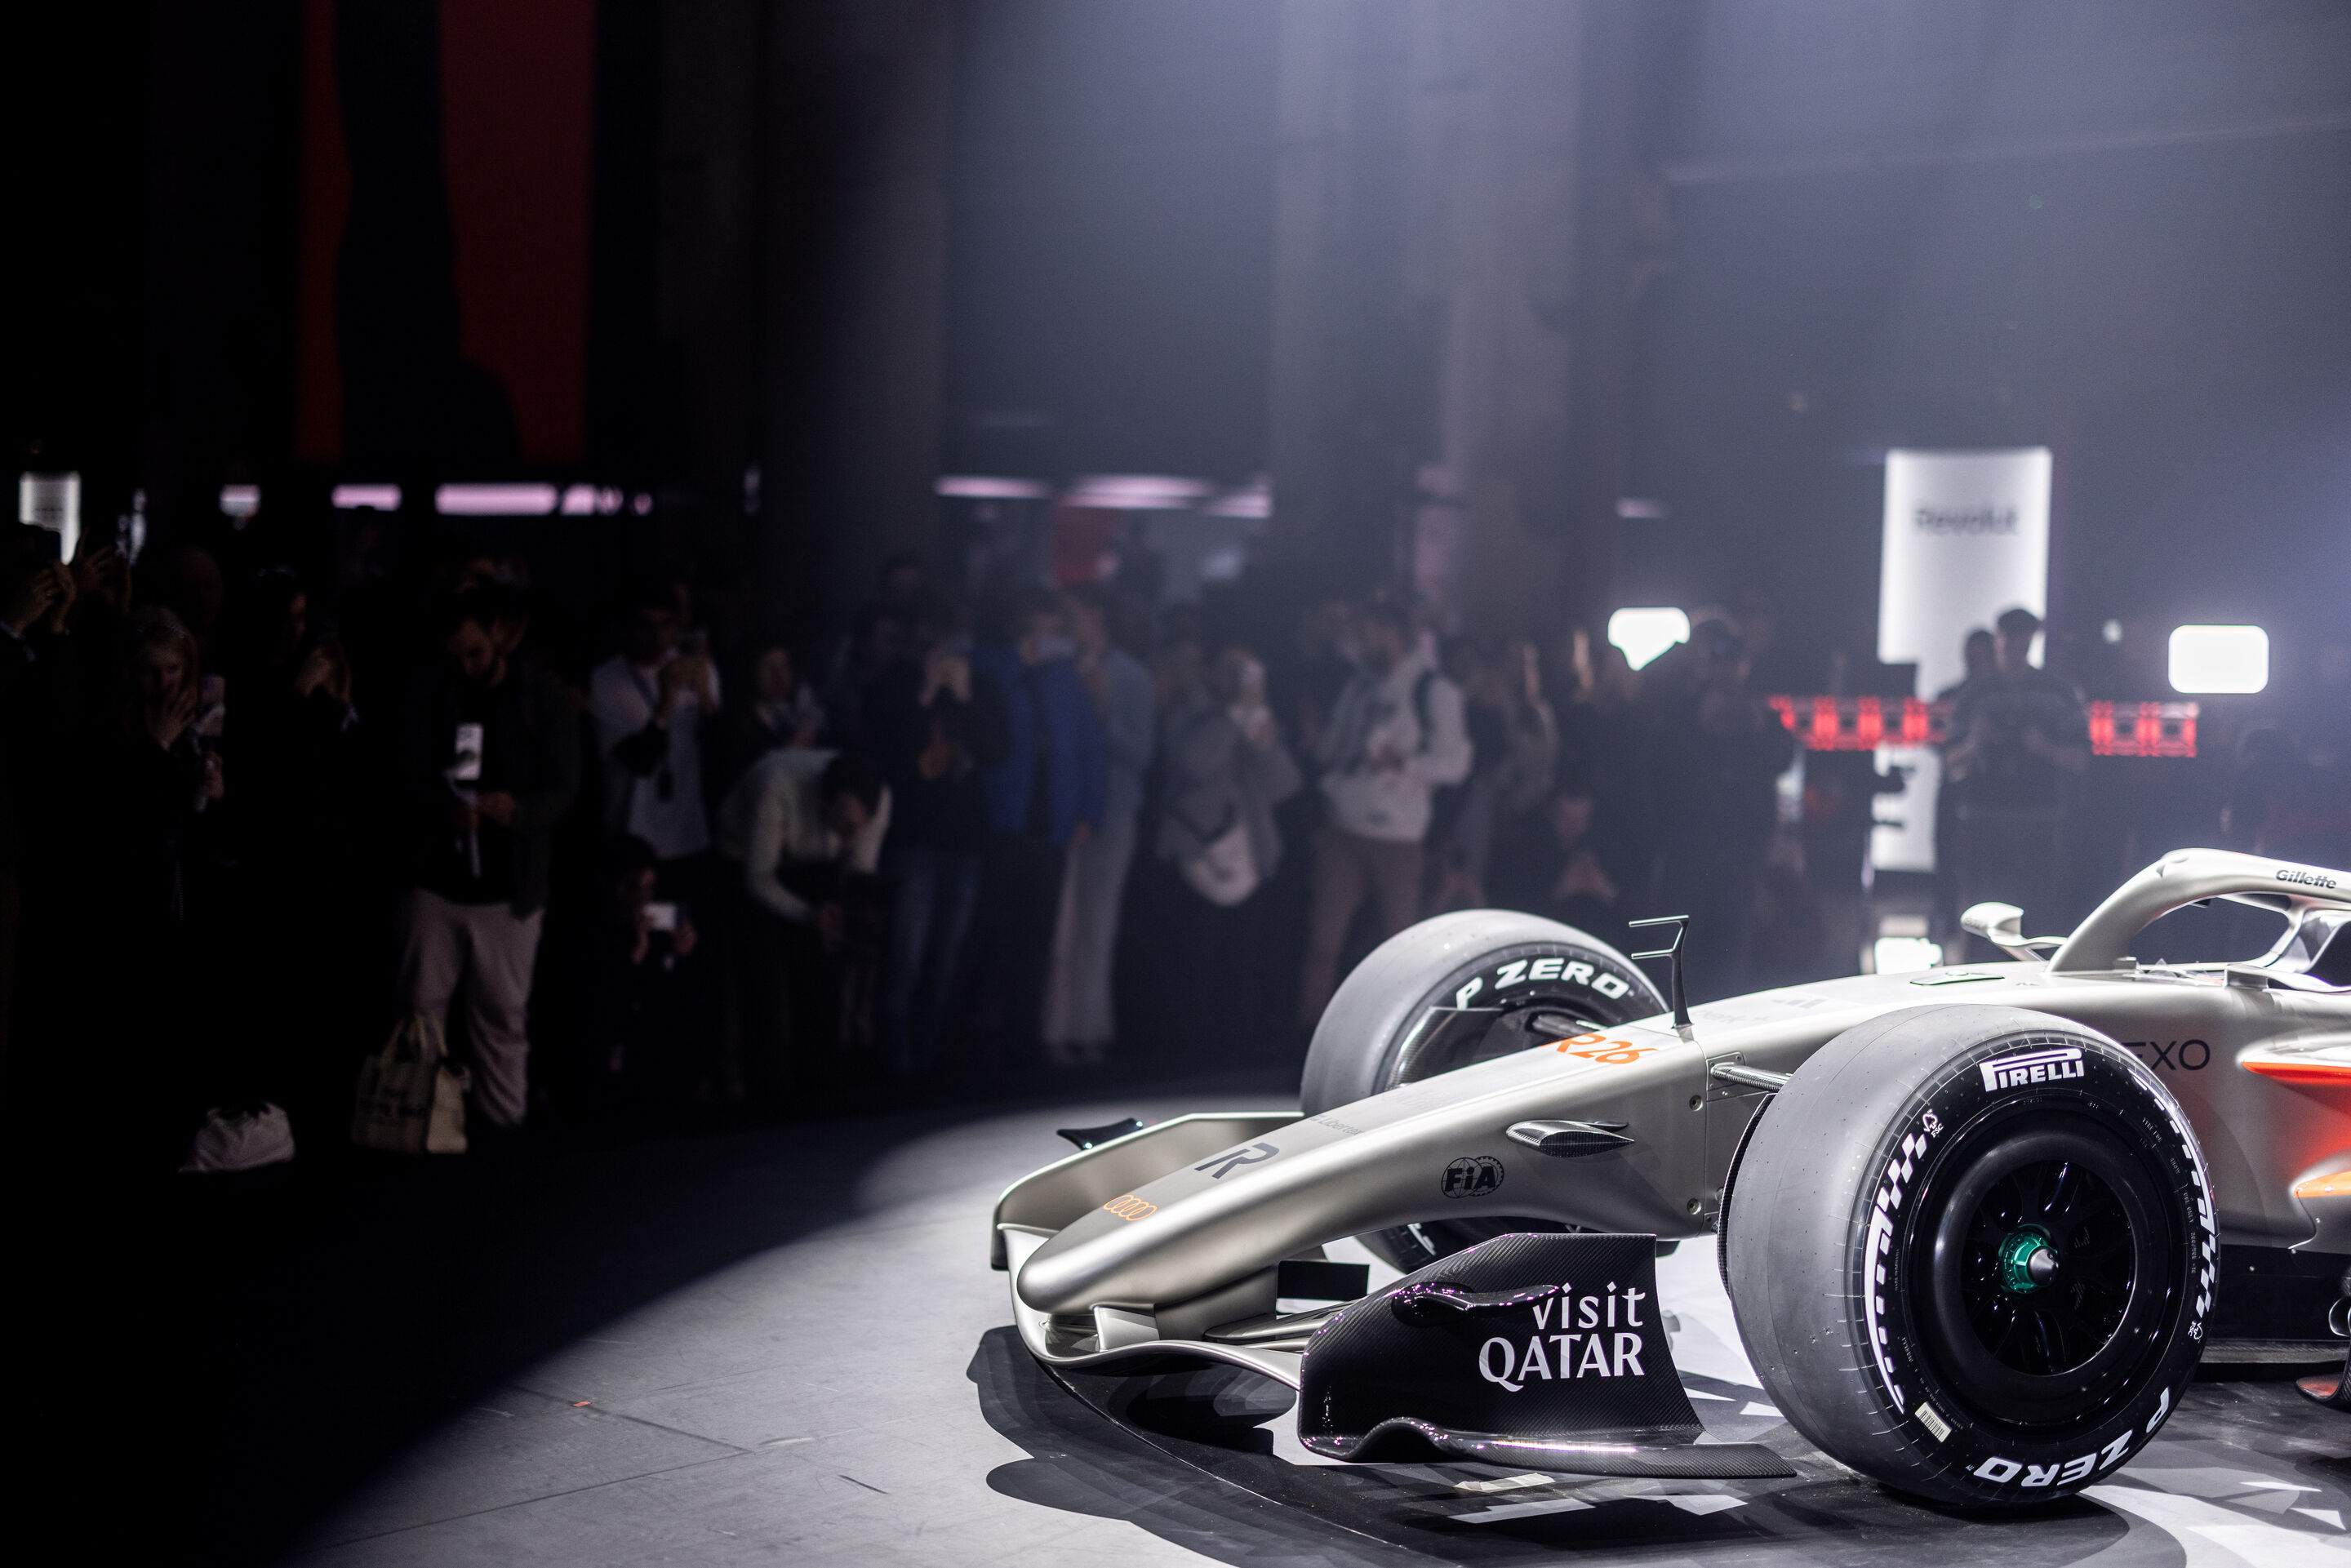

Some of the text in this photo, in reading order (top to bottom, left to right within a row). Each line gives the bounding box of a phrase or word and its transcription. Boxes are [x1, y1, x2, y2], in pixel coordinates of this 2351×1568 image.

[2276, 869, 2337, 889] Gillette
[1455, 957, 1629, 1011] P ZERO
[1539, 1033, 1659, 1064] R26
[1979, 1047, 2084, 1092] PIRELLI
[1531, 1281, 1646, 1330] visit
[1478, 1332, 1645, 1393] QATAR
[2145, 1386, 2170, 1433] P
[1973, 1429, 2133, 1487] ZERO
